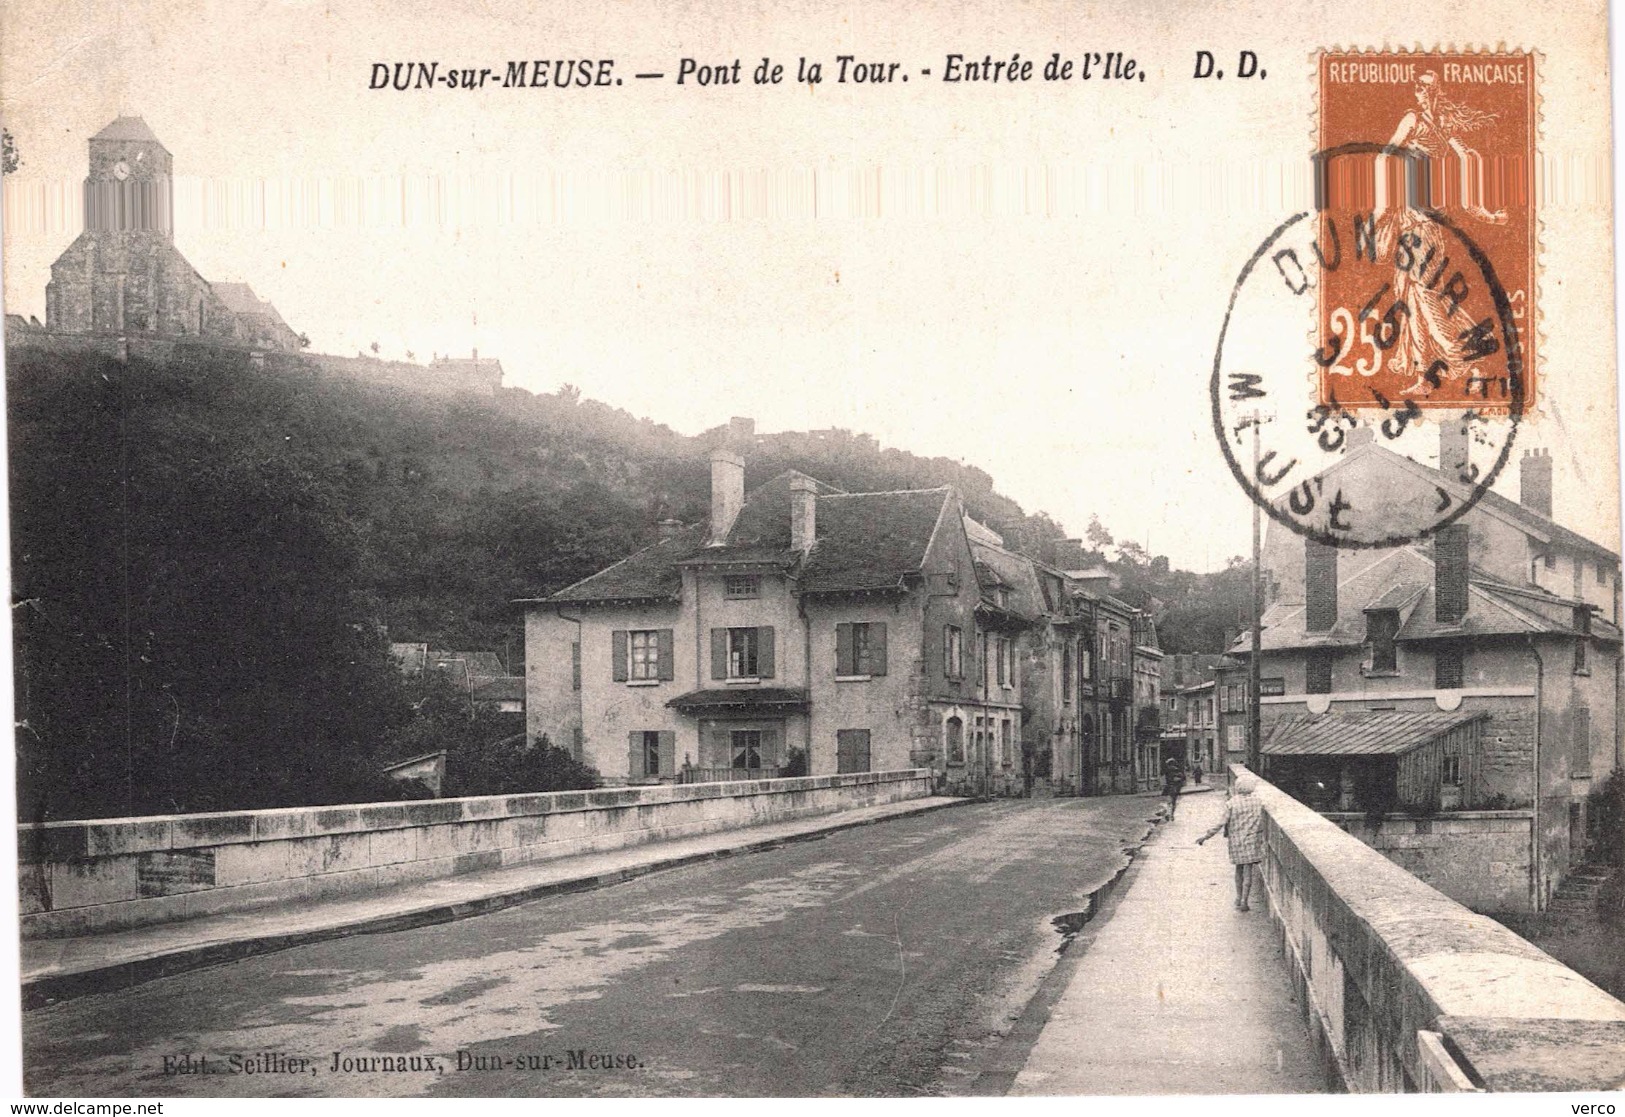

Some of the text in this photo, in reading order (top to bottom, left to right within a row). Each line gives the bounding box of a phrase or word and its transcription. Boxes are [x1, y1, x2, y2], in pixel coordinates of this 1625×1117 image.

[369, 59, 623, 91] DUN-sur-MEUSE.
[676, 58, 741, 86] Pont
[753, 57, 784, 84] de
[797, 57, 823, 84] la
[837, 55, 909, 83] Tour.
[942, 54, 1034, 83] Entrée
[1043, 54, 1074, 81] de
[1443, 62, 1525, 87] FRANÇAISE
[228, 1052, 318, 1077] Seillier,
[330, 1050, 445, 1076] Journaux,
[456, 1050, 646, 1074] Dun-sur-Meuse.
